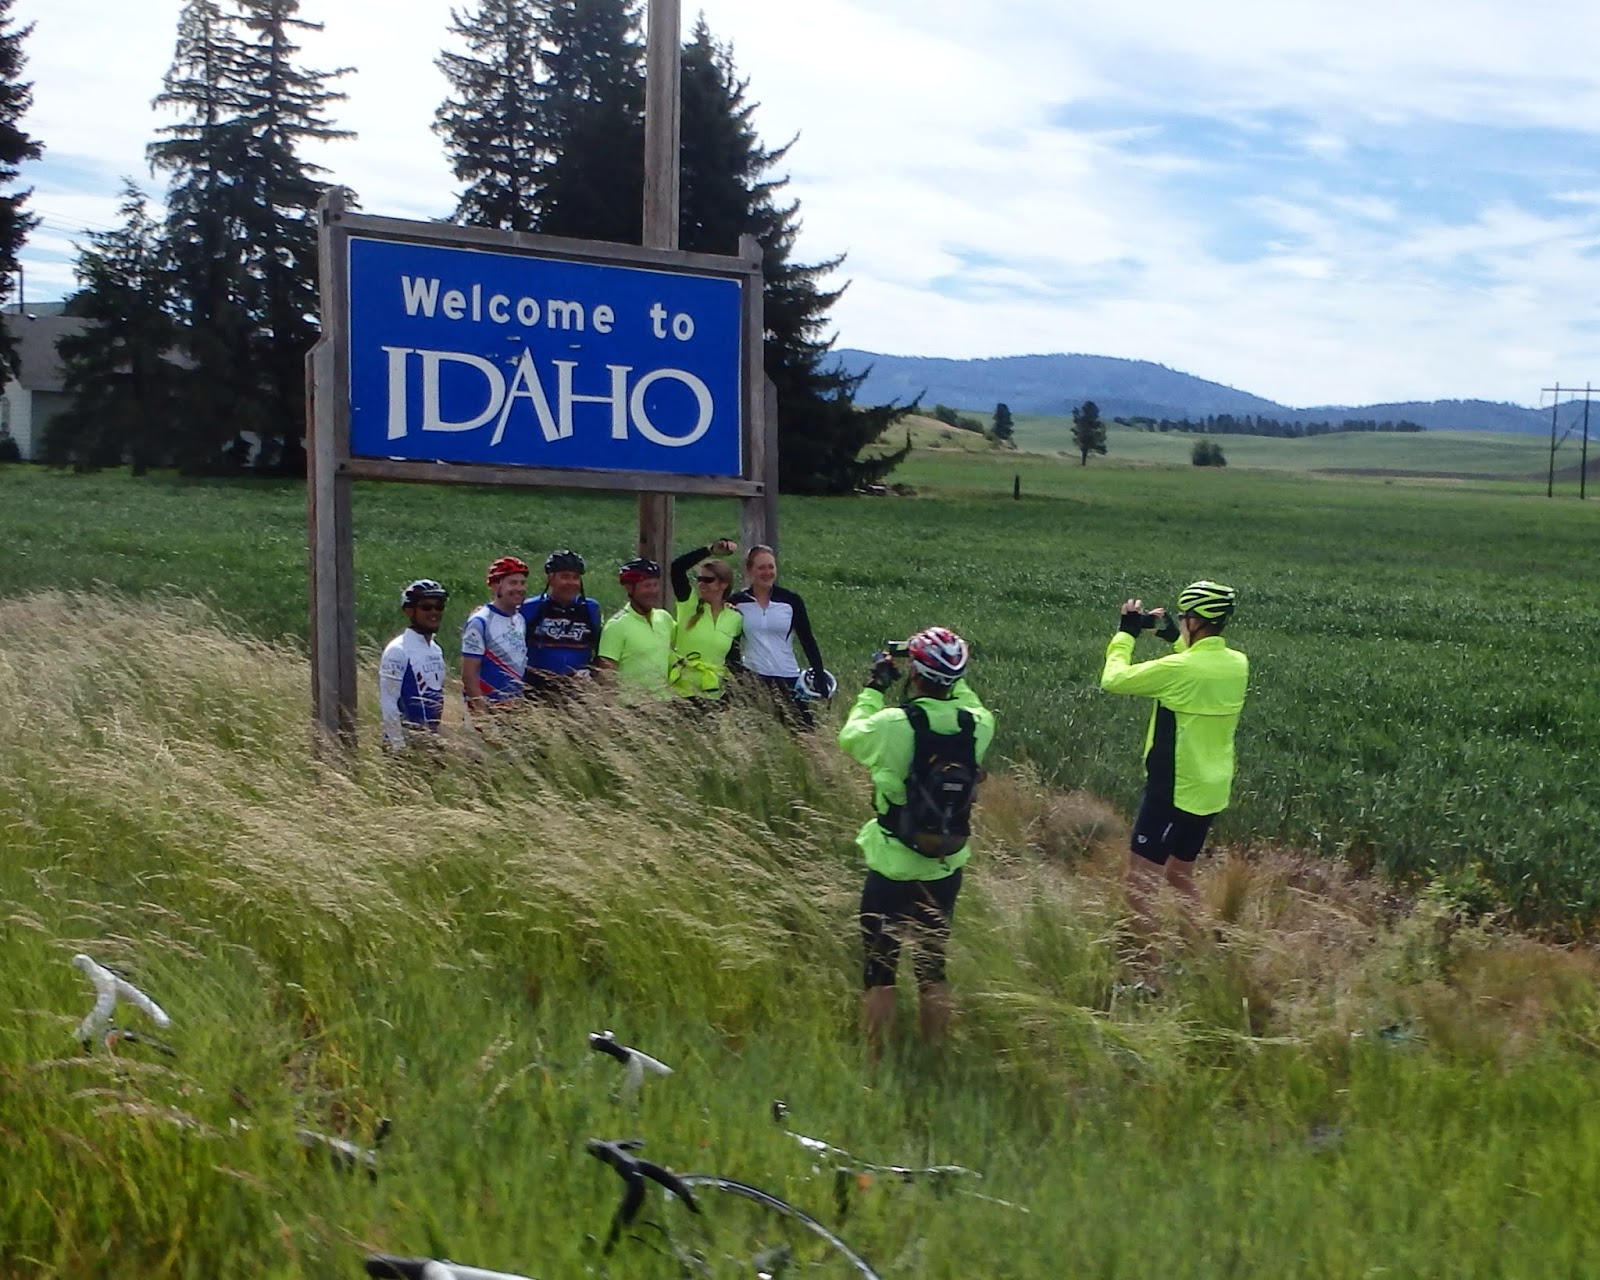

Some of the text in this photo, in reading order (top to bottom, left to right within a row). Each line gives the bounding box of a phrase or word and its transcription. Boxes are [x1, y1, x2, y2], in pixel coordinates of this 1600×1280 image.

[401, 275, 695, 341] Welcome to
[381, 346, 714, 447] IDAHO
